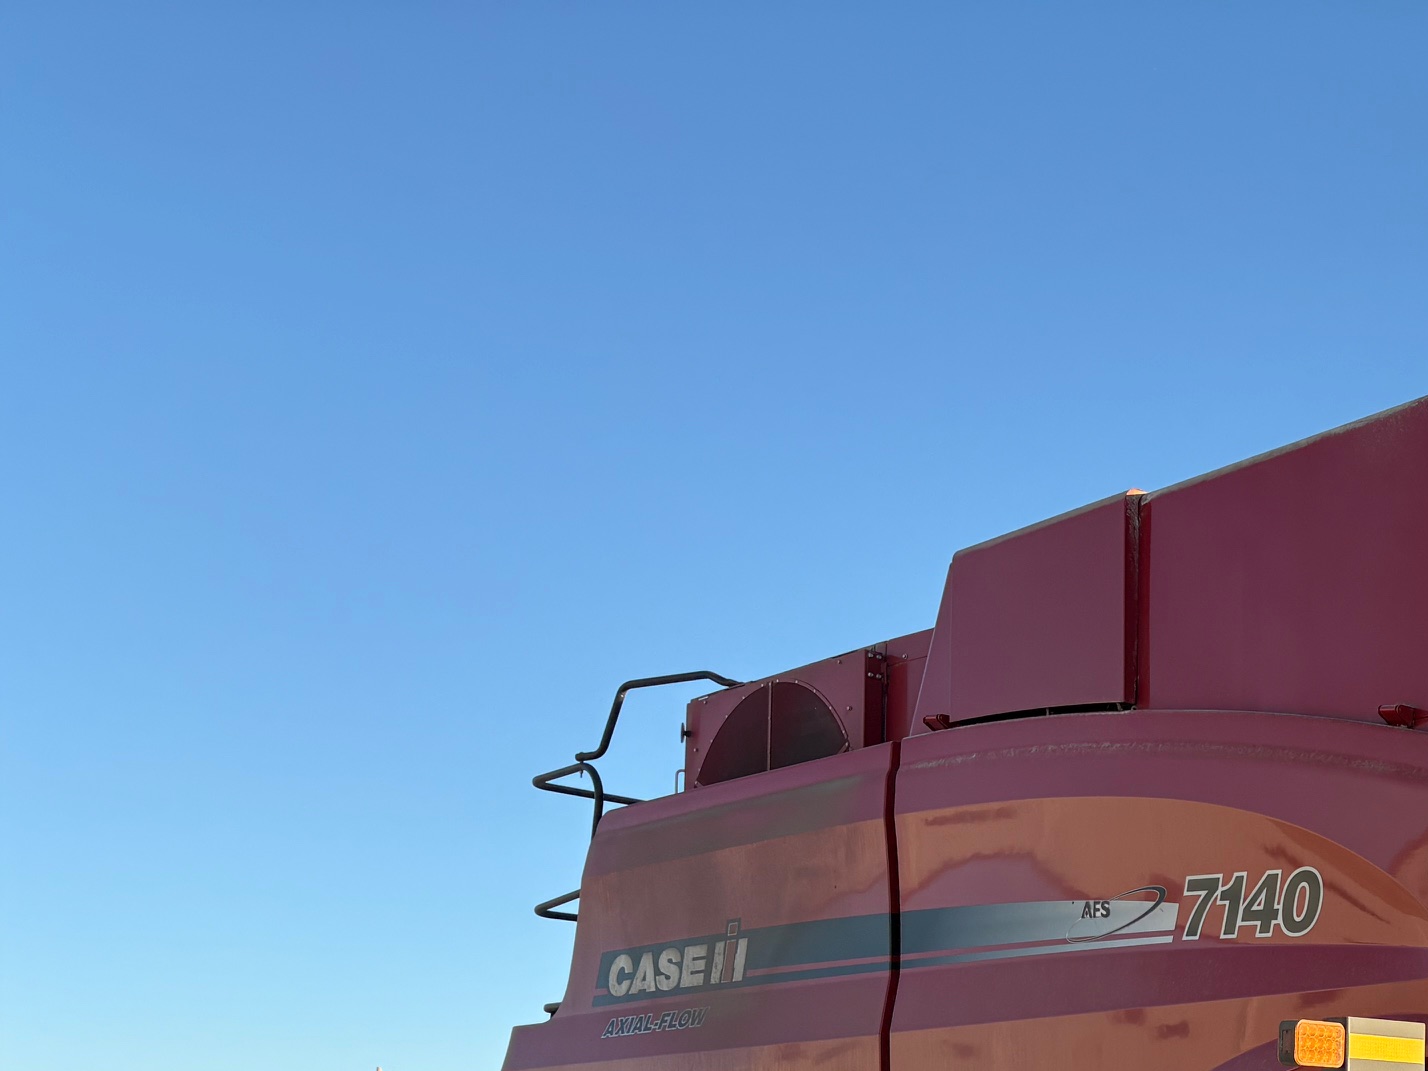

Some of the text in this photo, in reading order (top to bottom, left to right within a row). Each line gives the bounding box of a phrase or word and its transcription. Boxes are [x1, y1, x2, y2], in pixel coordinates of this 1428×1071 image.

[1081, 900, 1111, 919] AFS
[1182, 866, 1324, 941] 7140
[608, 943, 708, 997] CASE
[601, 1006, 711, 1039] AXIAL-FLOW
